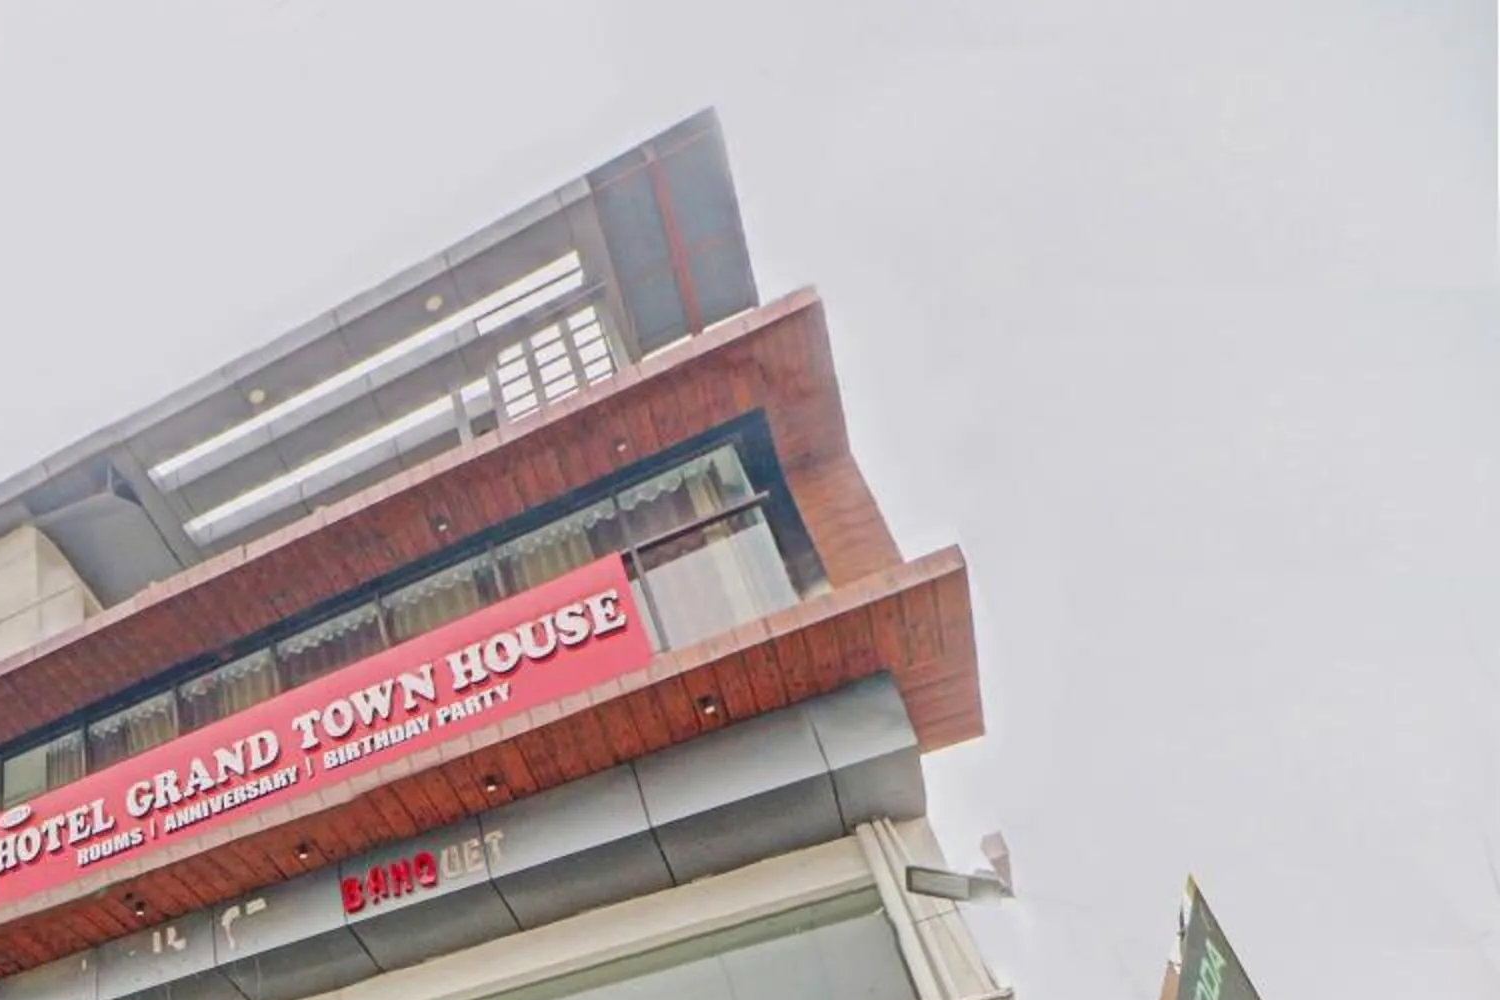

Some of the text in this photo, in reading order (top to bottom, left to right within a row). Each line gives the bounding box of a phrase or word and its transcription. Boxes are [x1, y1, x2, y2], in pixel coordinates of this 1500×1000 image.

[77, 682, 513, 867] ROOMS ANNIVERSARY BIRTHDAY PARTY
[125, 728, 281, 816] GRAND
[291, 662, 437, 749] TOWN
[445, 588, 628, 690] HOUSE
